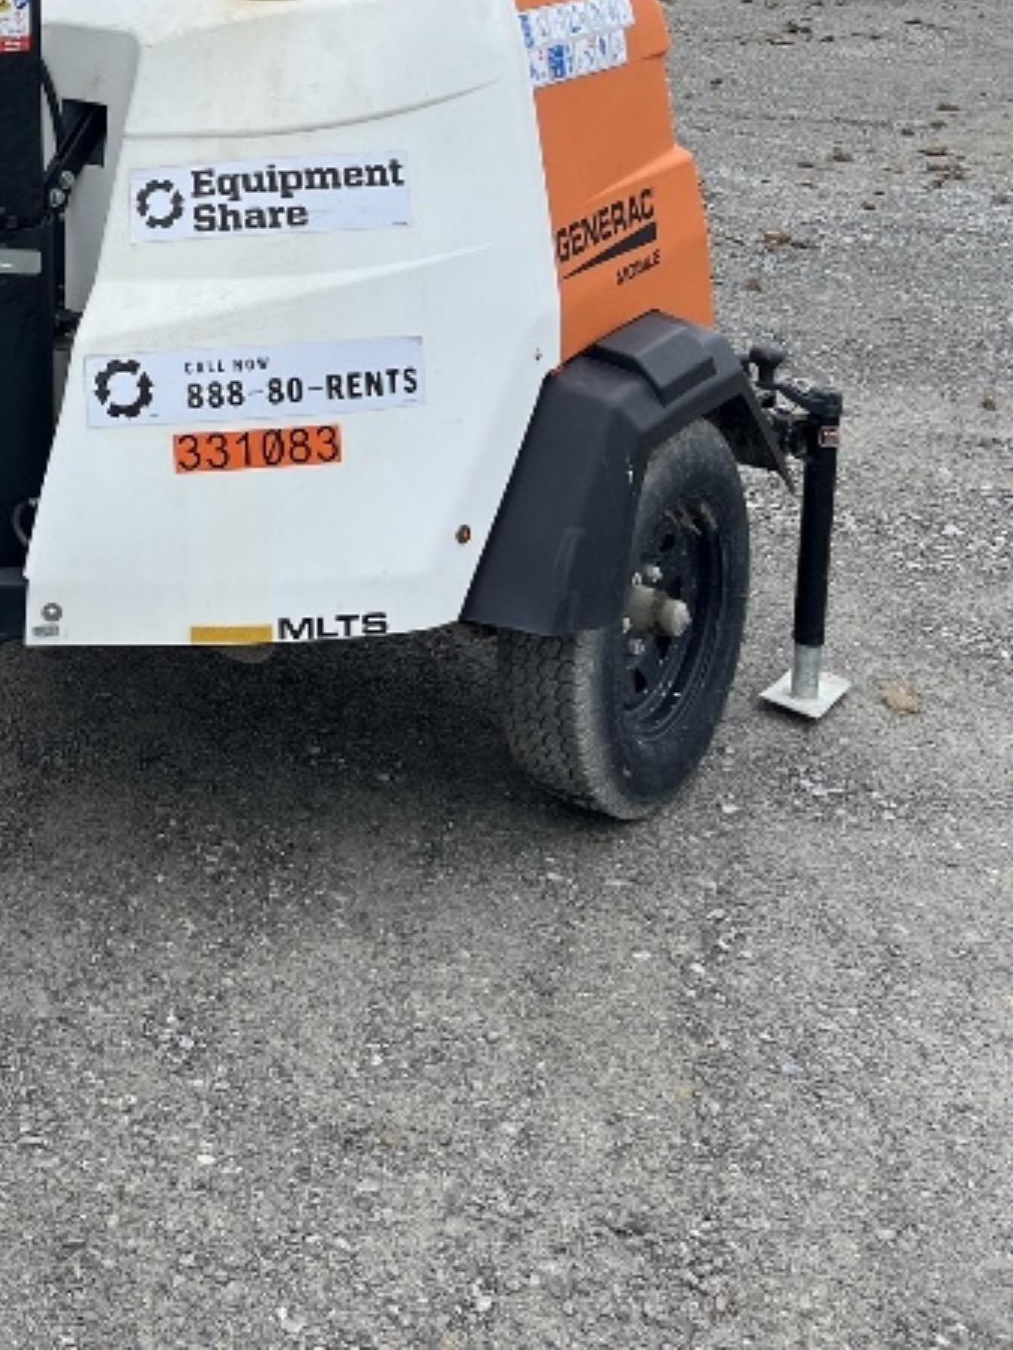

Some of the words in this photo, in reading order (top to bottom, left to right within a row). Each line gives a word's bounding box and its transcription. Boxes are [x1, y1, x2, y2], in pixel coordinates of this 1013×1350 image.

[190, 158, 406, 202] Equipment
[193, 203, 309, 233] Share
[556, 187, 655, 264] GENERAC
[187, 365, 419, 410] 888-80-RENTS
[177, 425, 339, 472] 331083
[277, 611, 388, 640] MLTS
